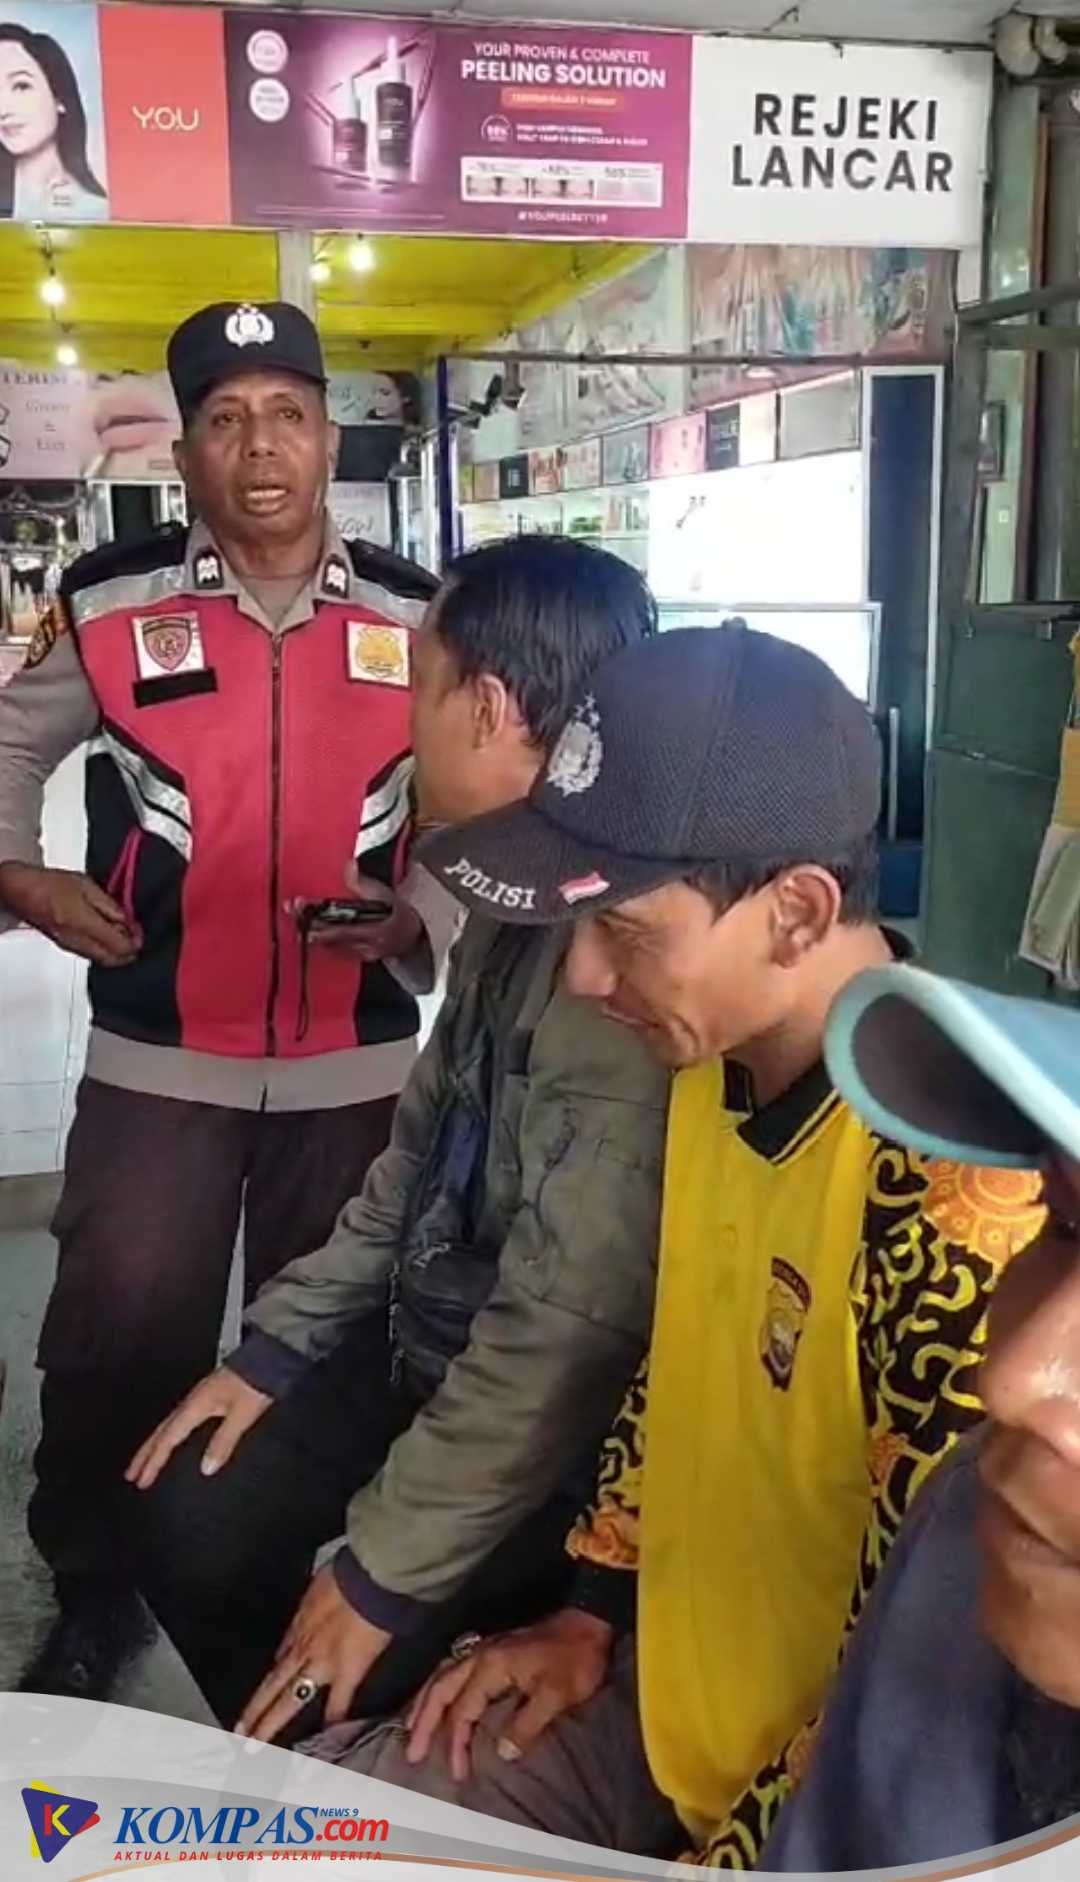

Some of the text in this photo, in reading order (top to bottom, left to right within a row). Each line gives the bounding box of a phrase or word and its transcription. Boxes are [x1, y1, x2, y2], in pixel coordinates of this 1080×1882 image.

[461, 59, 667, 89] PEELING SOLUTION
[474, 42, 651, 64] YOUR PROVEN & COMPLETE
[754, 93, 937, 141] REJEKI
[731, 144, 953, 192] LANCAR
[444, 857, 537, 910] POLISI
